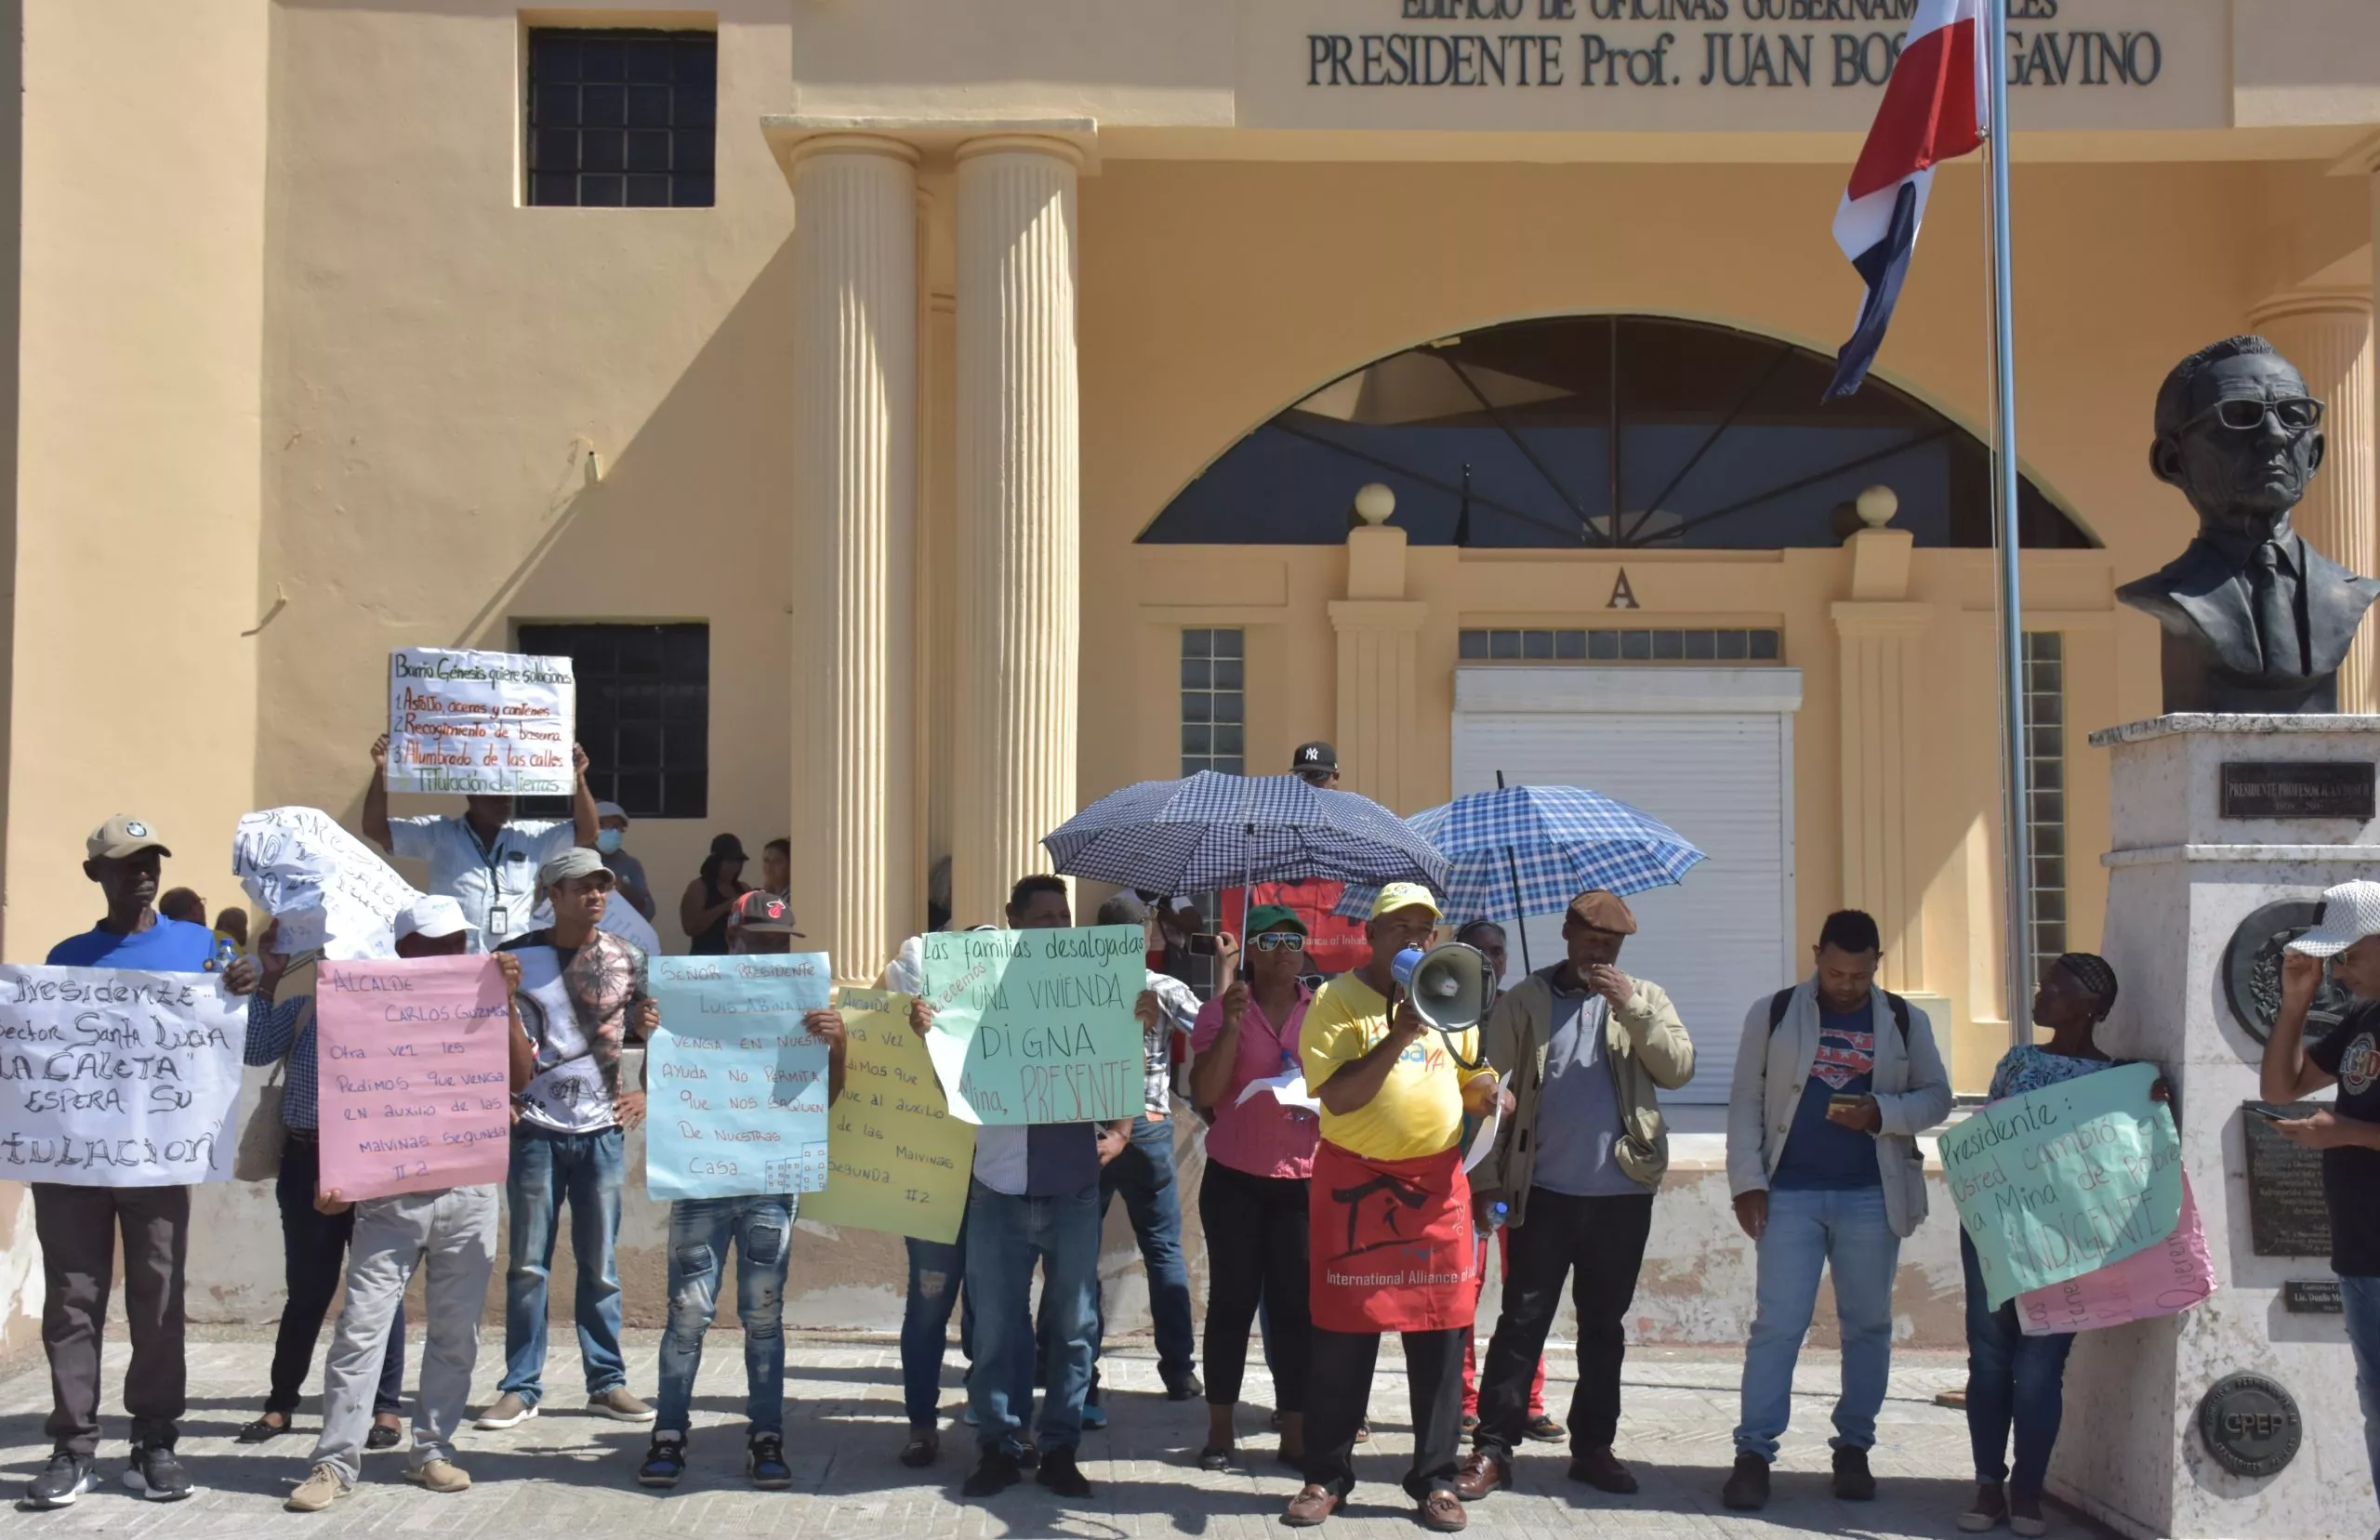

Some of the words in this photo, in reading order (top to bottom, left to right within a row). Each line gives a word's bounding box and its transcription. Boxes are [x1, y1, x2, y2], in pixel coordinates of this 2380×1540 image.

[1307, 34, 1562, 86] PRESIDENTE
[1580, 35, 1678, 86] Prof.
[1699, 33, 1812, 86] JUAN
[1605, 565, 1640, 609] A
[395, 654, 434, 678] Barrio
[489, 665, 520, 690] quiere
[522, 662, 572, 685] soluciones
[492, 704, 500, 719] y
[494, 720, 509, 739] de
[404, 740, 472, 766] Alumbrado
[483, 744, 498, 767] de
[507, 744, 526, 767] las
[530, 745, 564, 767] calles
[490, 769, 510, 793] de
[924, 935, 949, 960] Las
[964, 935, 1032, 969] familias
[1046, 930, 1144, 967] desalojadas
[333, 969, 415, 993] ALCALDE
[932, 961, 986, 1014] erecemos
[972, 982, 1009, 1012] UNA
[1027, 973, 1125, 1010] VIVIENDA
[385, 1004, 450, 1022] CARLOS
[700, 994, 737, 1015] LUIS
[330, 1044, 365, 1060] Otra
[443, 1042, 465, 1055] les
[671, 1036, 722, 1051] VENGA
[740, 1037, 762, 1050] EN
[980, 1022, 1097, 1060] DIGNA
[729, 1069, 748, 1084] NO
[24, 1087, 126, 1115] ESPERA
[147, 1085, 193, 1114] SU
[729, 1097, 758, 1110] NOS
[871, 1093, 884, 1108] al
[1020, 1060, 1133, 1123] PRESENTE
[384, 1103, 436, 1119] auxilio
[451, 1099, 469, 1113] de
[480, 1098, 503, 1111] las
[837, 1115, 853, 1132] de
[863, 1123, 884, 1139] las
[1994, 1181, 2059, 1220] Mina
[2077, 1154, 2109, 1191] de
[1327, 1269, 1404, 1286] International
[1408, 1269, 1459, 1283] Alliance
